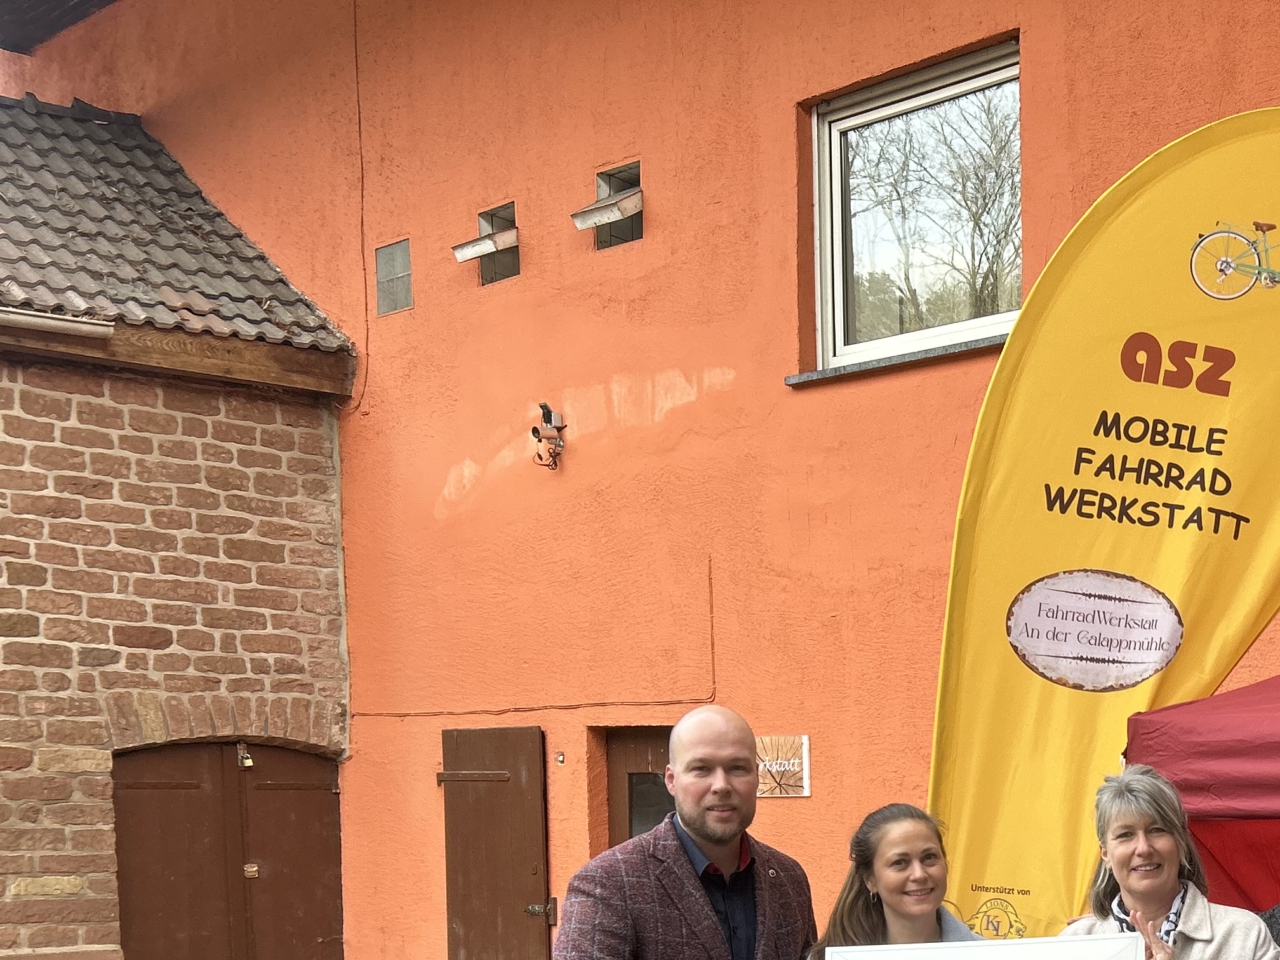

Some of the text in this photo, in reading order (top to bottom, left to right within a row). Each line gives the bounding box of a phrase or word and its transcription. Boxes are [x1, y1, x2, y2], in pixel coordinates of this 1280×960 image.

[1120, 331, 1237, 397] asz
[1093, 410, 1228, 456] MOBILE
[1073, 447, 1232, 496] FAHRRAD
[1044, 483, 1250, 540] WERKSTATT
[1037, 602, 1158, 631] FahrradWerkstatt
[1019, 622, 1171, 654] An der Galappmühle
[758, 756, 801, 772] rkstatt
[971, 884, 1031, 896] Unterstützt von
[985, 901, 1009, 910] LIONS
